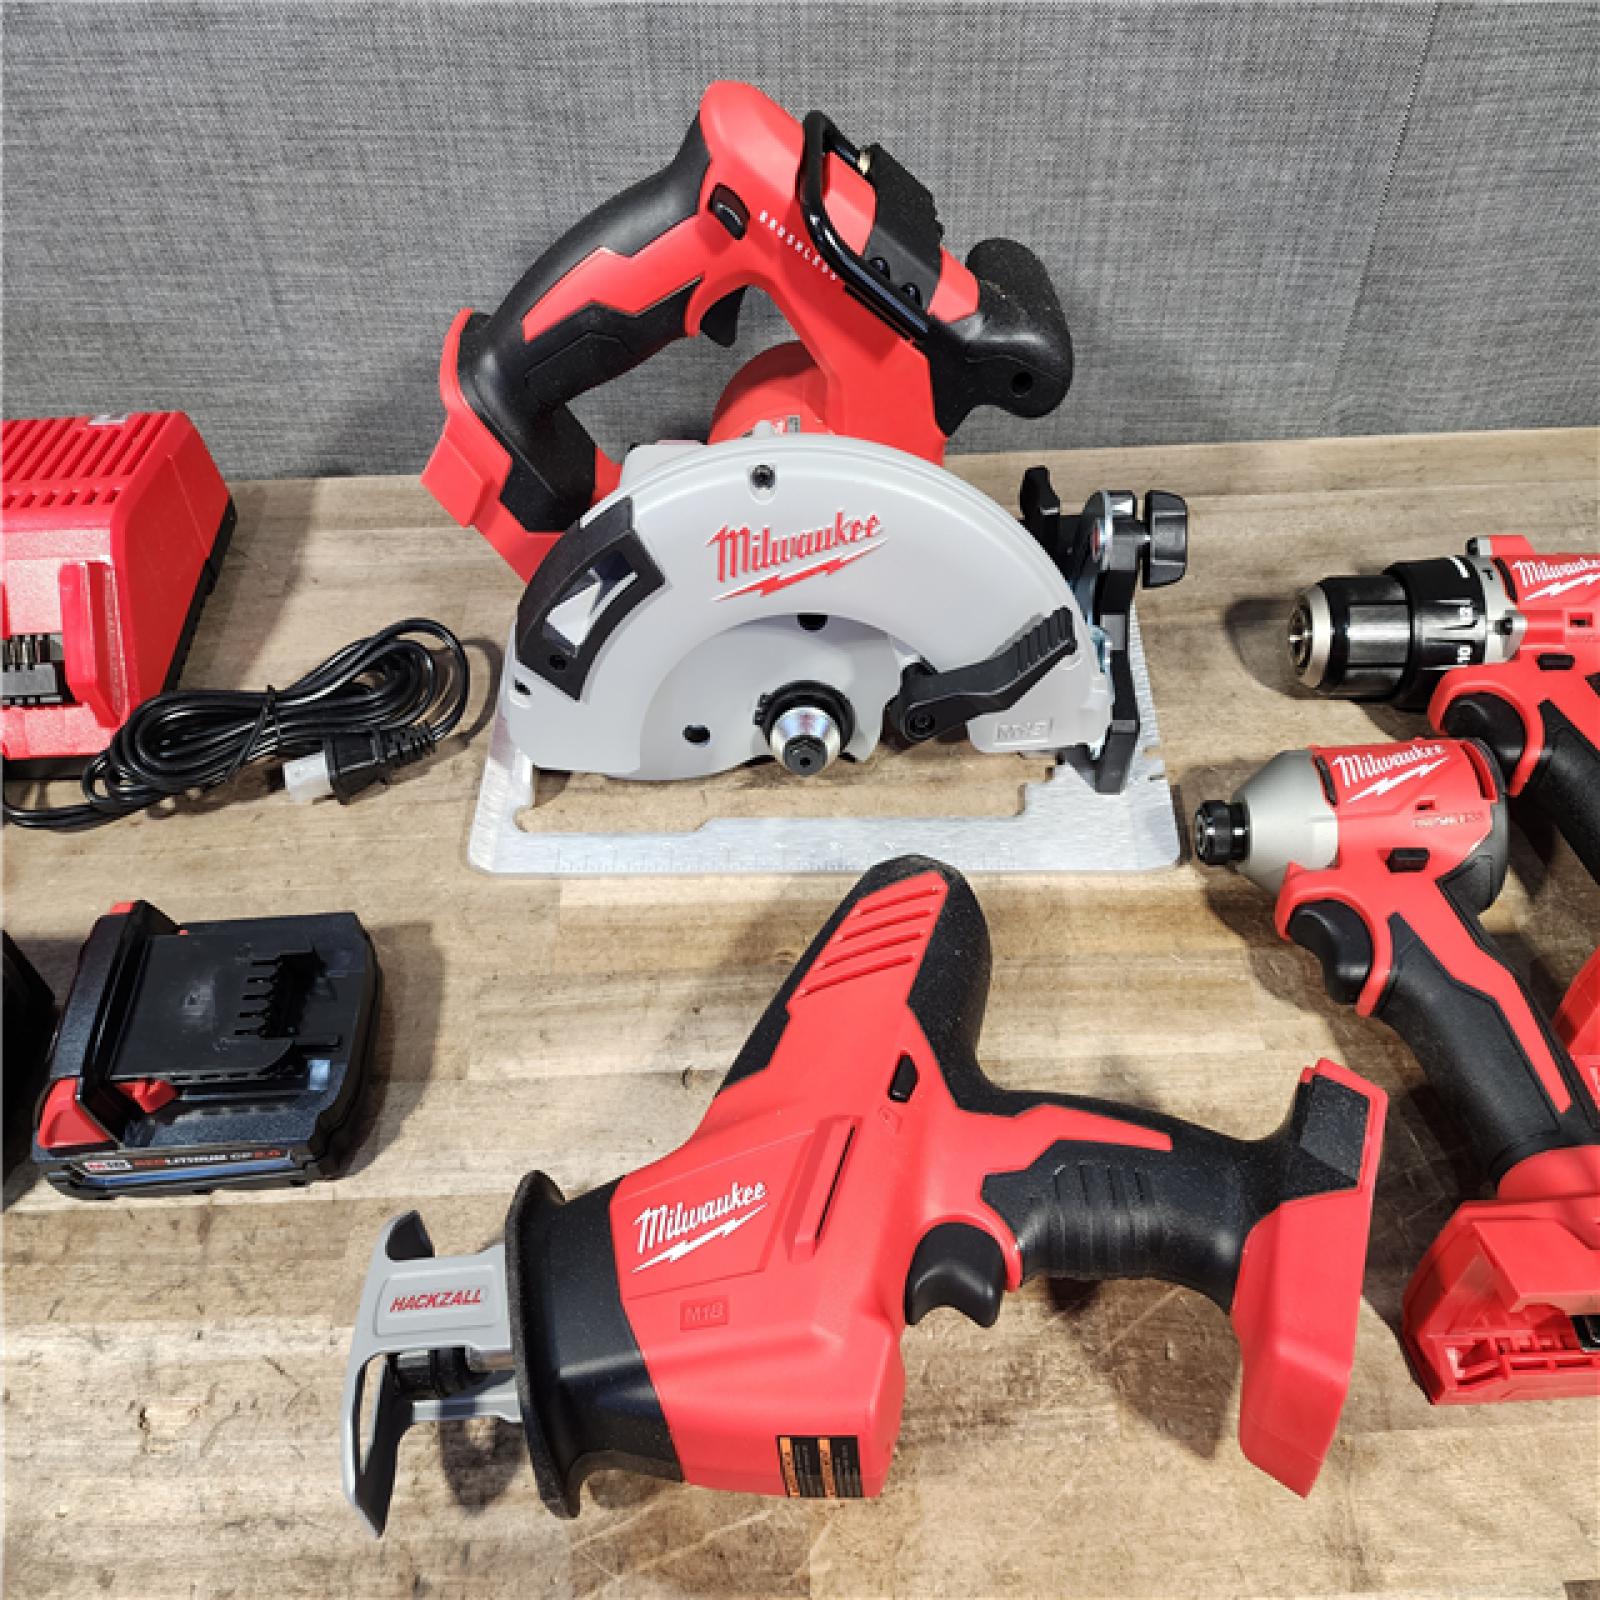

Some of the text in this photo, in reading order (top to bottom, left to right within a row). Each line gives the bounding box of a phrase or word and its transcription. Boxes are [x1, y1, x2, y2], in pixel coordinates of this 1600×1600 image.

[705, 509, 882, 583] Milwaukee
[1332, 744, 1445, 788] Milwaukee
[632, 1181, 768, 1254] Milwaukee
[390, 1288, 481, 1312] HACKZALL
[684, 1302, 724, 1321] M18
